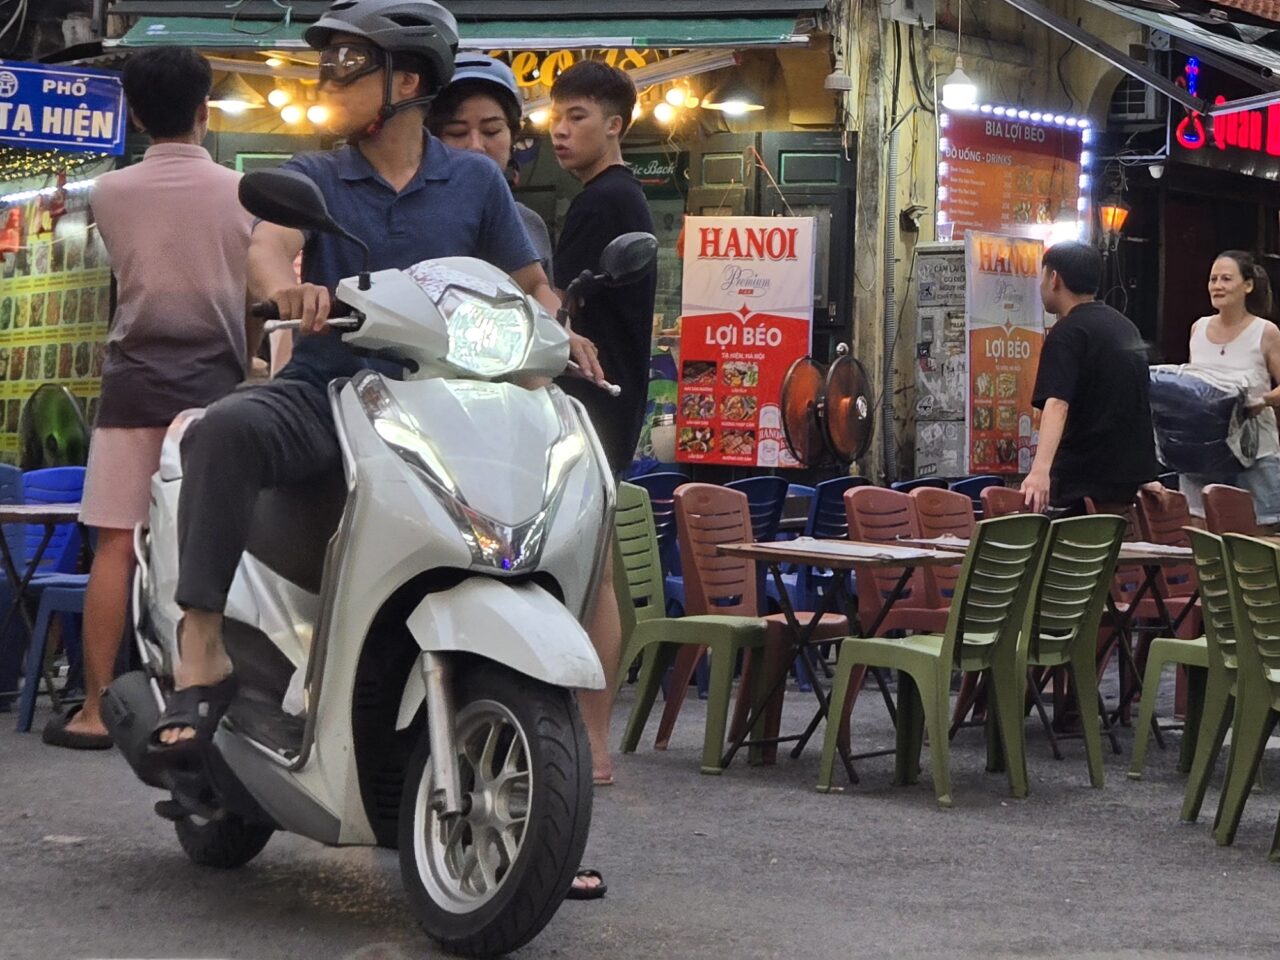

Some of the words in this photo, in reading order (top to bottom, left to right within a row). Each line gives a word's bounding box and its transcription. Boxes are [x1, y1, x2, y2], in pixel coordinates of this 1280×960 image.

[42, 77, 90, 97] PHỐ
[0, 102, 34, 137] TẠ
[42, 103, 114, 142] HIỆN
[985, 120, 1003, 139] BIA
[1005, 123, 1022, 143] LỢI
[958, 147, 981, 162] UỐNG
[986, 153, 1012, 166] DRINKS
[697, 227, 799, 261] HANOI
[720, 264, 771, 291] Premium
[705, 323, 738, 350] LỢI
[743, 323, 782, 347] BÉO
[986, 338, 1005, 362] LỢI
[1008, 337, 1030, 359] BÉO
